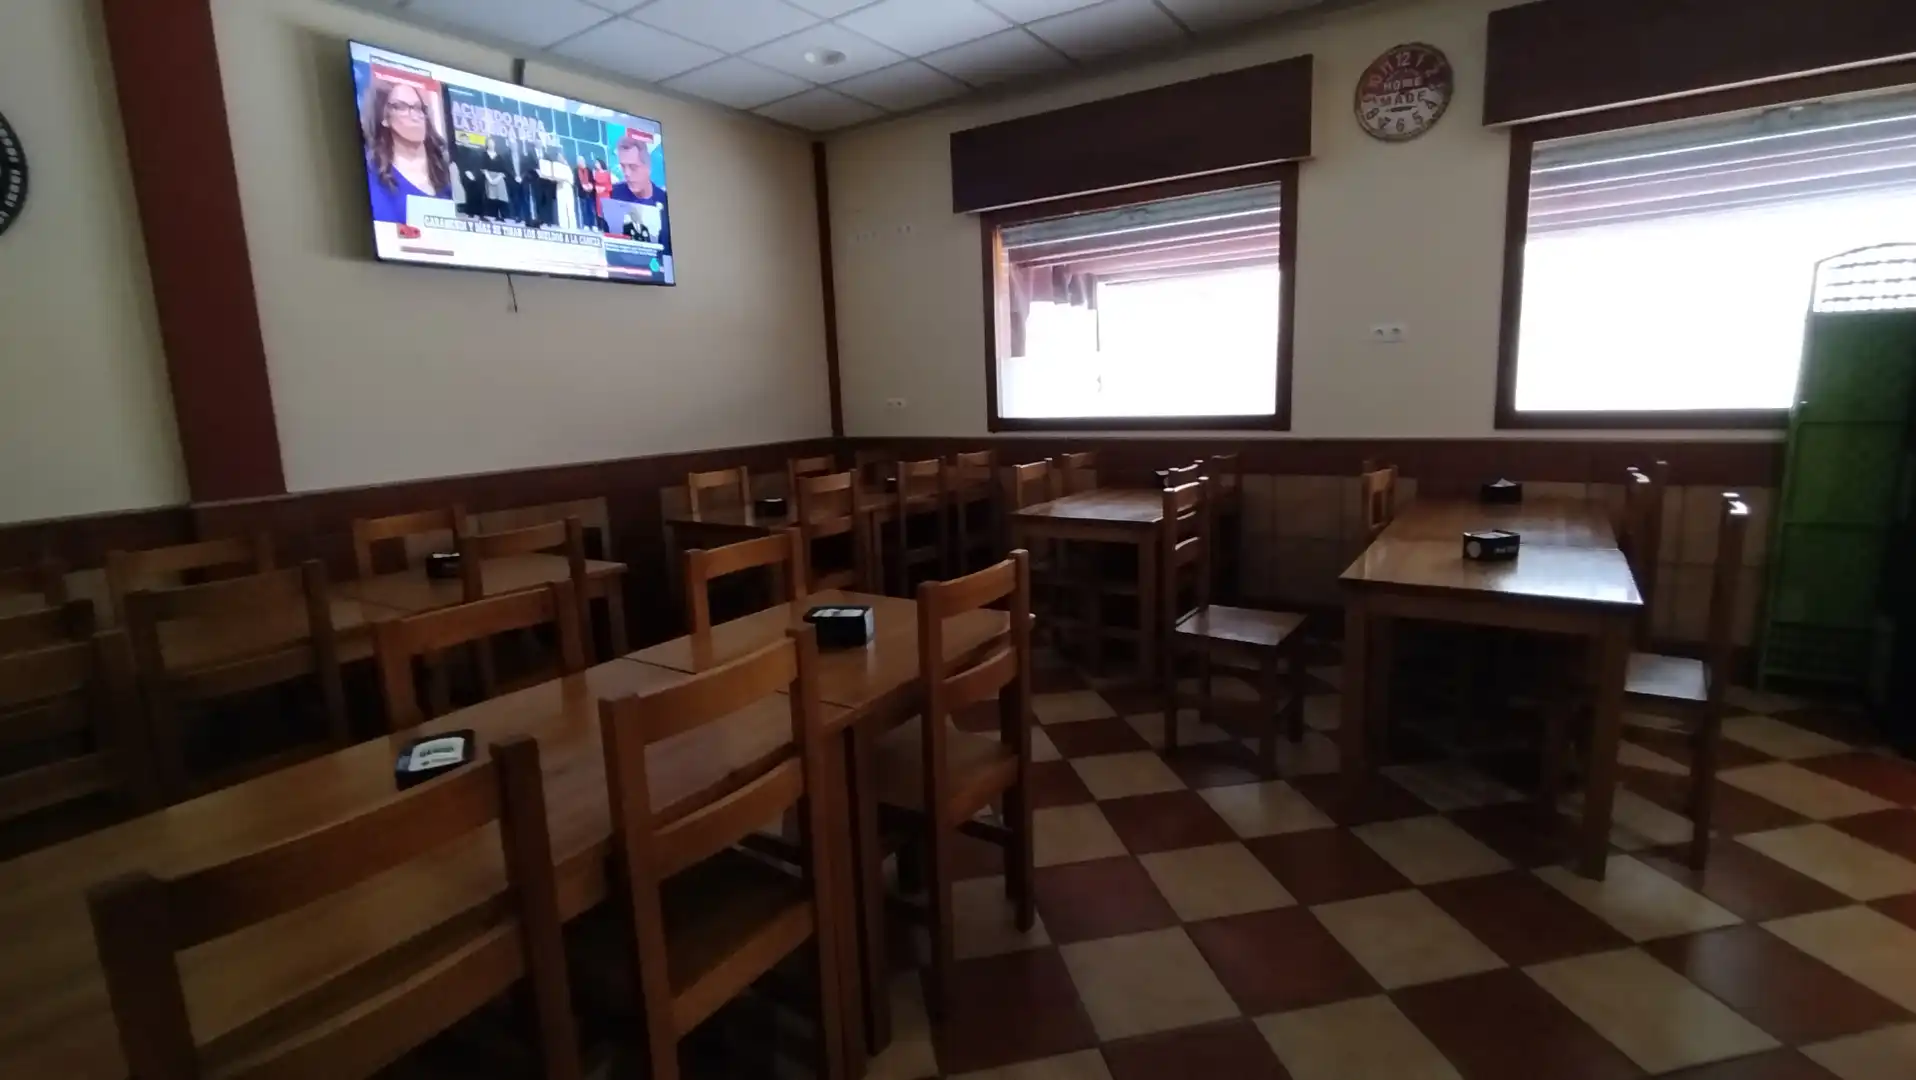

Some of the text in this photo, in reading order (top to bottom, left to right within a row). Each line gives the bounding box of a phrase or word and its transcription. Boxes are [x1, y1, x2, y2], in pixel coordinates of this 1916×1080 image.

[1395, 51, 1411, 67] 12
[1379, 90, 1427, 105] MADE
[1395, 117, 1406, 133] 6
